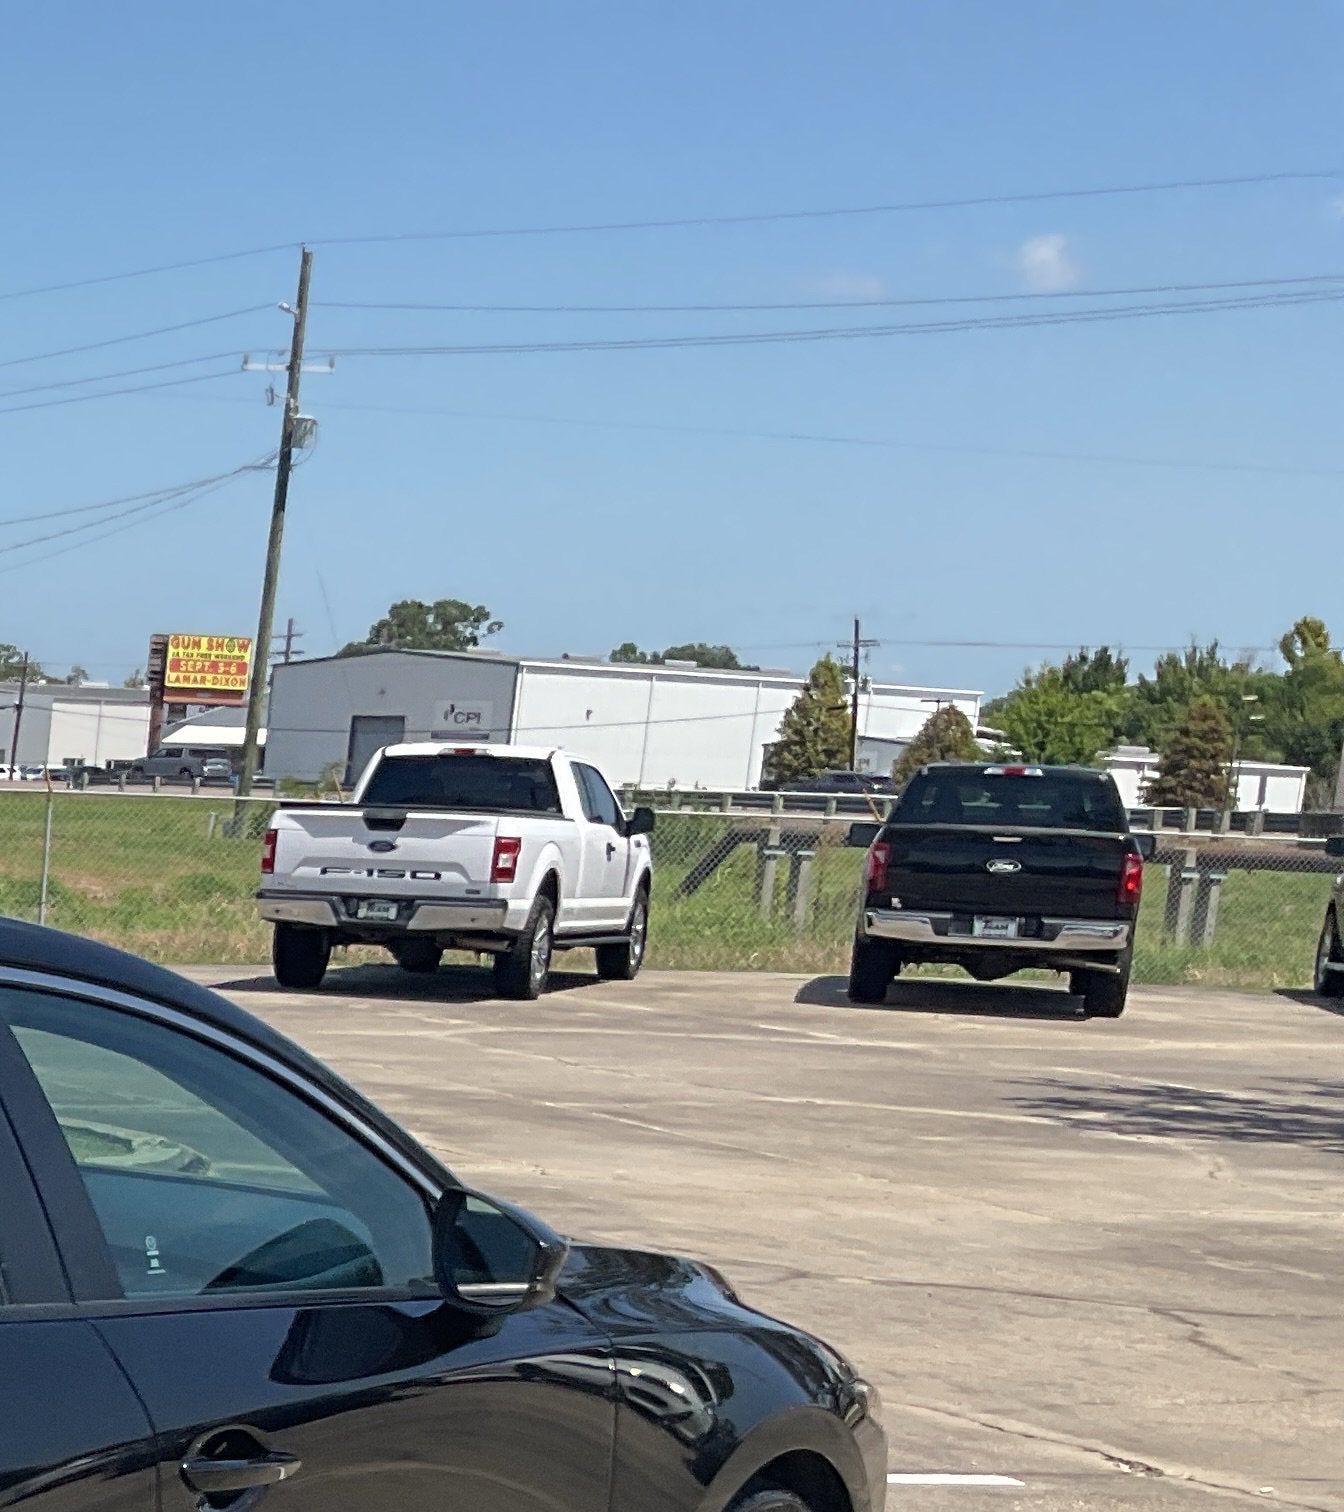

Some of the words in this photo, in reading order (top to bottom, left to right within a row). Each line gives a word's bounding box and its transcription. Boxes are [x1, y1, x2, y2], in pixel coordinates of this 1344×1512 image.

[171, 635, 202, 651] GUN
[167, 673, 247, 688] LAMAR-DIXON
[453, 711, 481, 725] CPI
[319, 866, 442, 881] F-150
